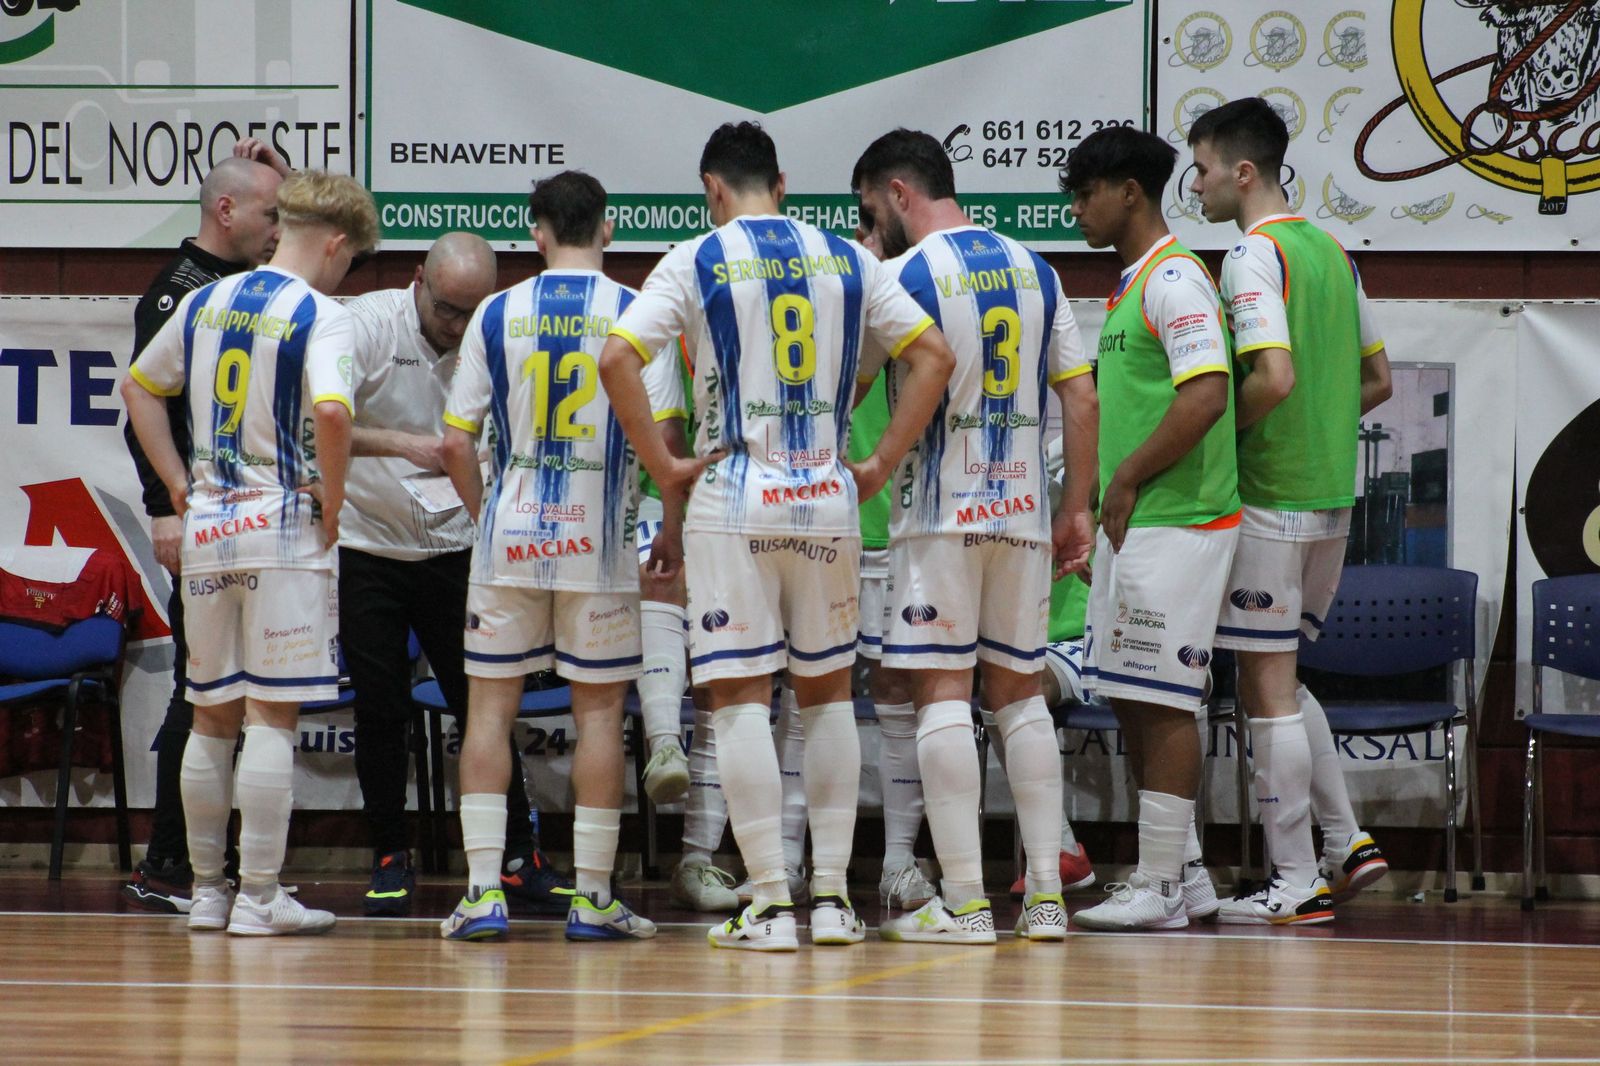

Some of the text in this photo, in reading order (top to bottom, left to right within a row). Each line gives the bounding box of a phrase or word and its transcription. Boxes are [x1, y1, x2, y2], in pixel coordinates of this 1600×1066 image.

[982, 120, 1024, 141] 661
[1036, 120, 1082, 141] 612
[9, 120, 341, 187] DEL NOROSTE
[390, 143, 564, 165] BENAVENTE
[982, 147, 1074, 168] 647 52
[381, 203, 536, 229] CONSTRUCCIO
[604, 205, 717, 230] PROMOCIO
[1017, 204, 1077, 230] REFO
[1540, 201, 1566, 214] 2017
[711, 254, 853, 285] SERGIO SIMON
[934, 267, 1041, 299] V.MONTES
[540, 290, 586, 301] ALAMEDA
[191, 306, 299, 343] PAAPPANEN
[509, 314, 613, 338] GUANCHO
[769, 293, 817, 386] 8
[980, 305, 1022, 400] 3
[1100, 329, 1127, 359] sport
[392, 355, 420, 368] sport
[213, 347, 252, 437] 9
[520, 350, 598, 442] 12
[790, 448, 832, 462] VALLES
[988, 461, 1028, 474] VALLES
[762, 479, 841, 505] MACIAS
[543, 504, 587, 516] VALLES
[956, 494, 1036, 527] MACIAS
[194, 513, 270, 548] MACIAS
[506, 536, 594, 563] MACIAS
[750, 537, 838, 564] BUSANAUTO
[1128, 616, 1166, 630] ZAMORA
[1129, 644, 1160, 654] BENAVENTE
[1123, 660, 1157, 672] uhlsport
[293, 725, 357, 754] uis
